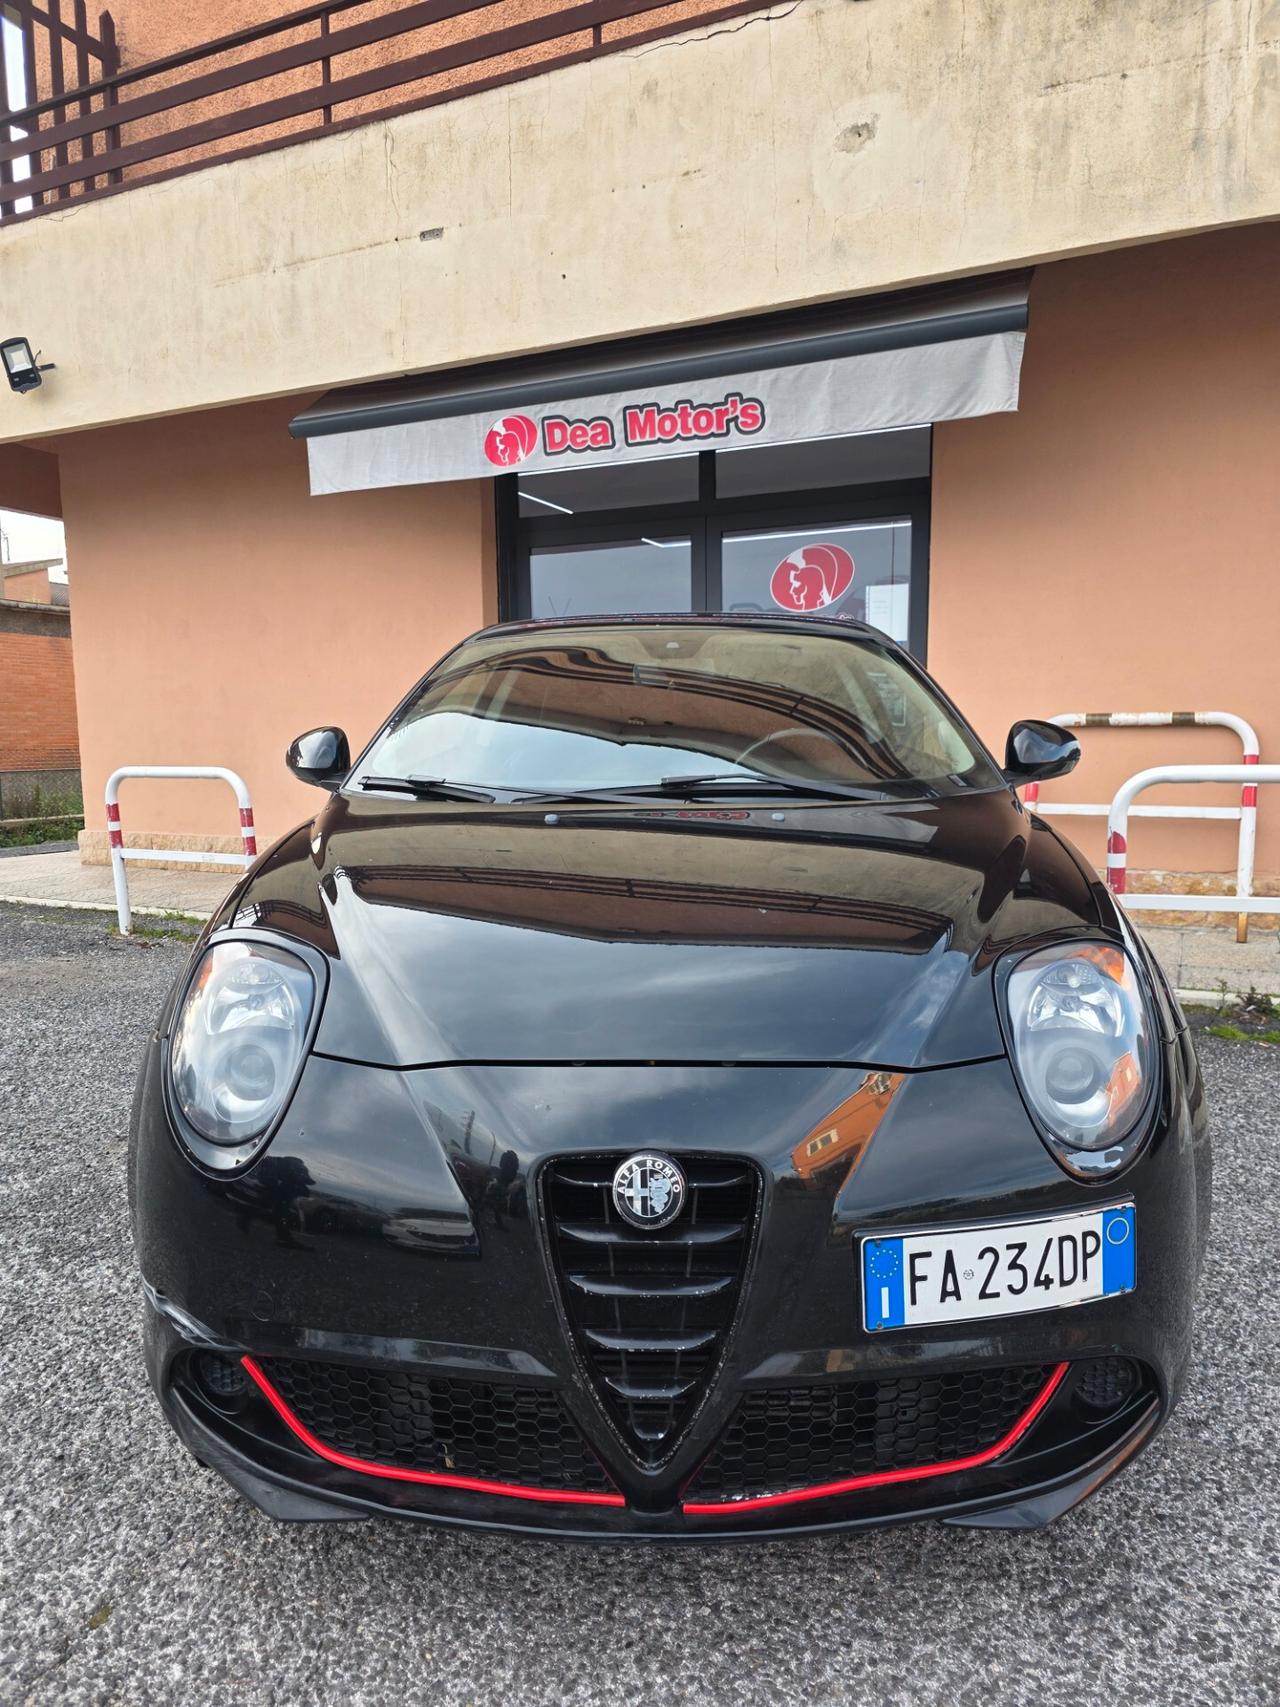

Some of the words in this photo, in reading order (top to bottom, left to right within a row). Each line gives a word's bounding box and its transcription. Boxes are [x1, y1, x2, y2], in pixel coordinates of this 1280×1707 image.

[542, 416, 615, 455] Dea
[624, 392, 765, 446] Motor's
[618, 1163, 639, 1194] ALFA
[646, 1160, 680, 1193] ROMEO
